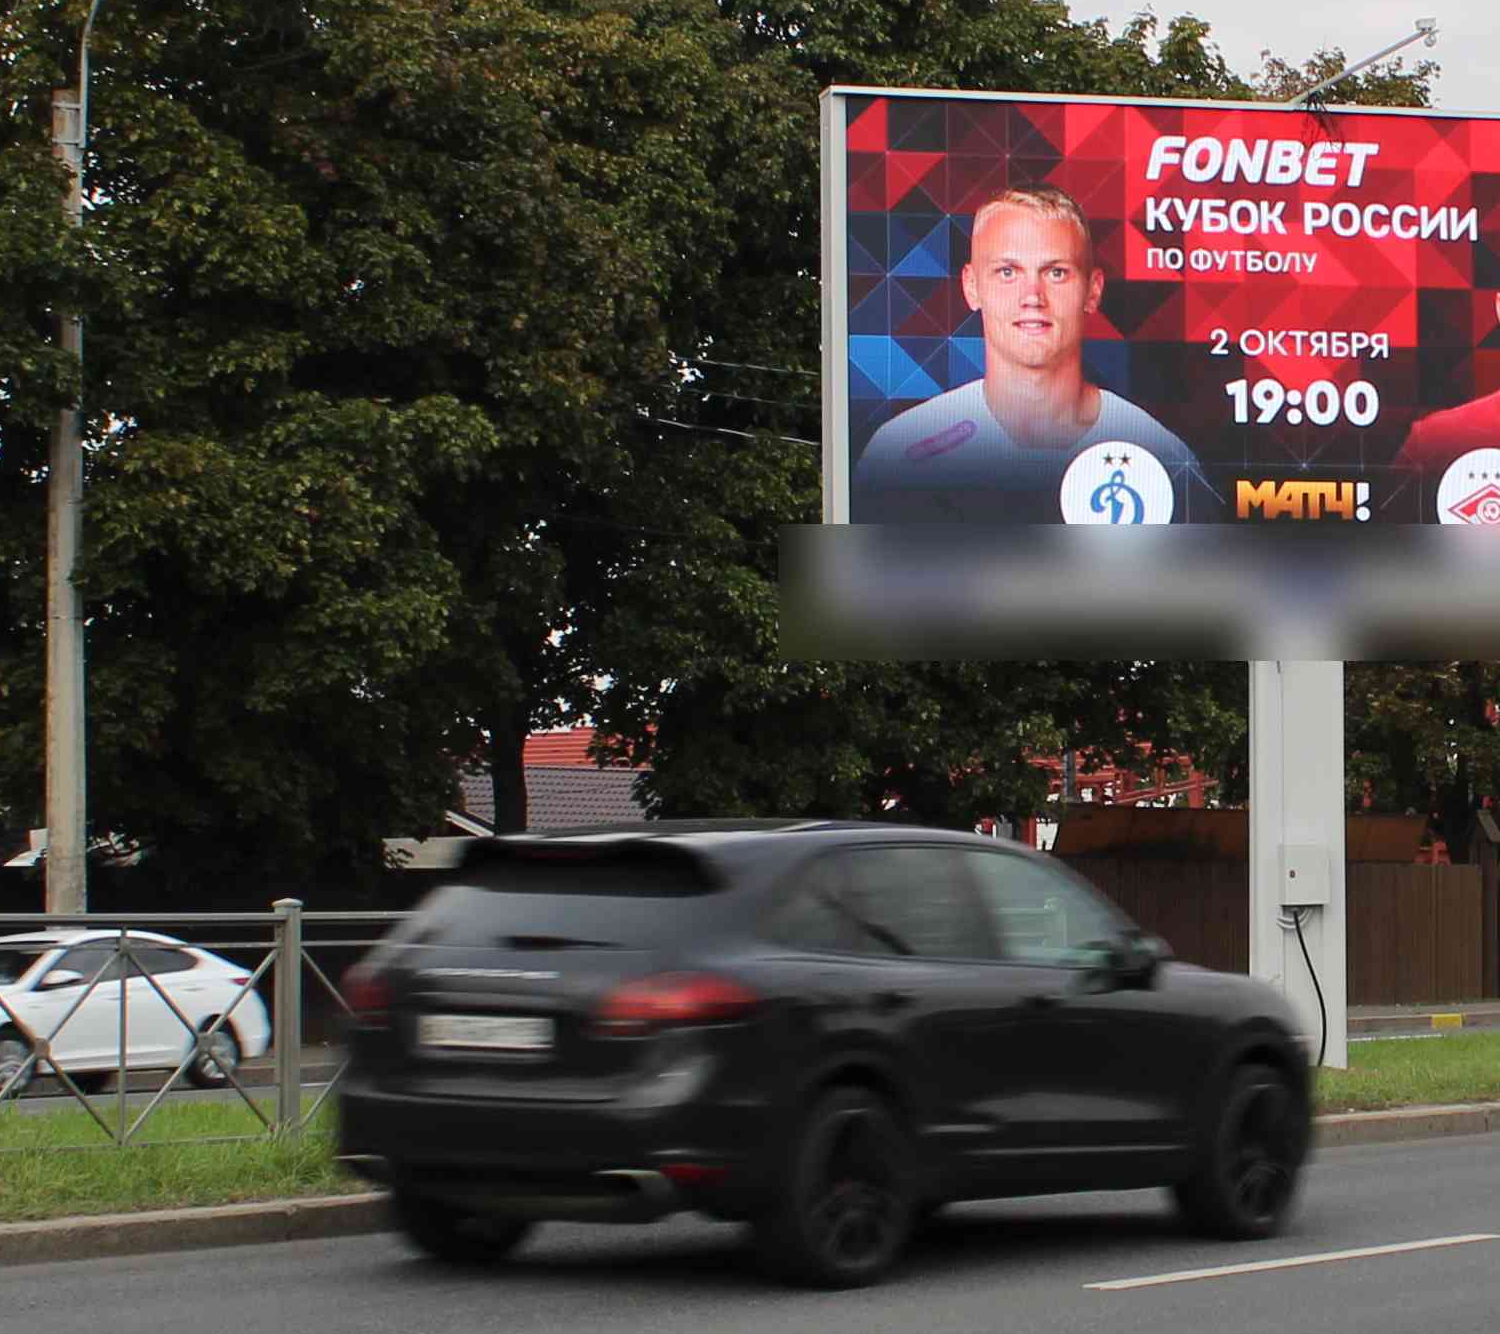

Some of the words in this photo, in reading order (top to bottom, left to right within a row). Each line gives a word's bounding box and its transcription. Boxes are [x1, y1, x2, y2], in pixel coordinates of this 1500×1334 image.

[1145, 135, 1379, 187] FONBET
[1145, 197, 1287, 235] КУБОК
[1303, 202, 1478, 241] РОССИИ
[1147, 247, 1184, 270] ПО
[1190, 247, 1317, 273] ФУТБОЛУ
[1210, 329, 1229, 355] 2
[1239, 329, 1389, 358] ОКТЯБРЯ
[1225, 378, 1380, 427] 19:00
[1236, 480, 1371, 522] МАТЧ!
